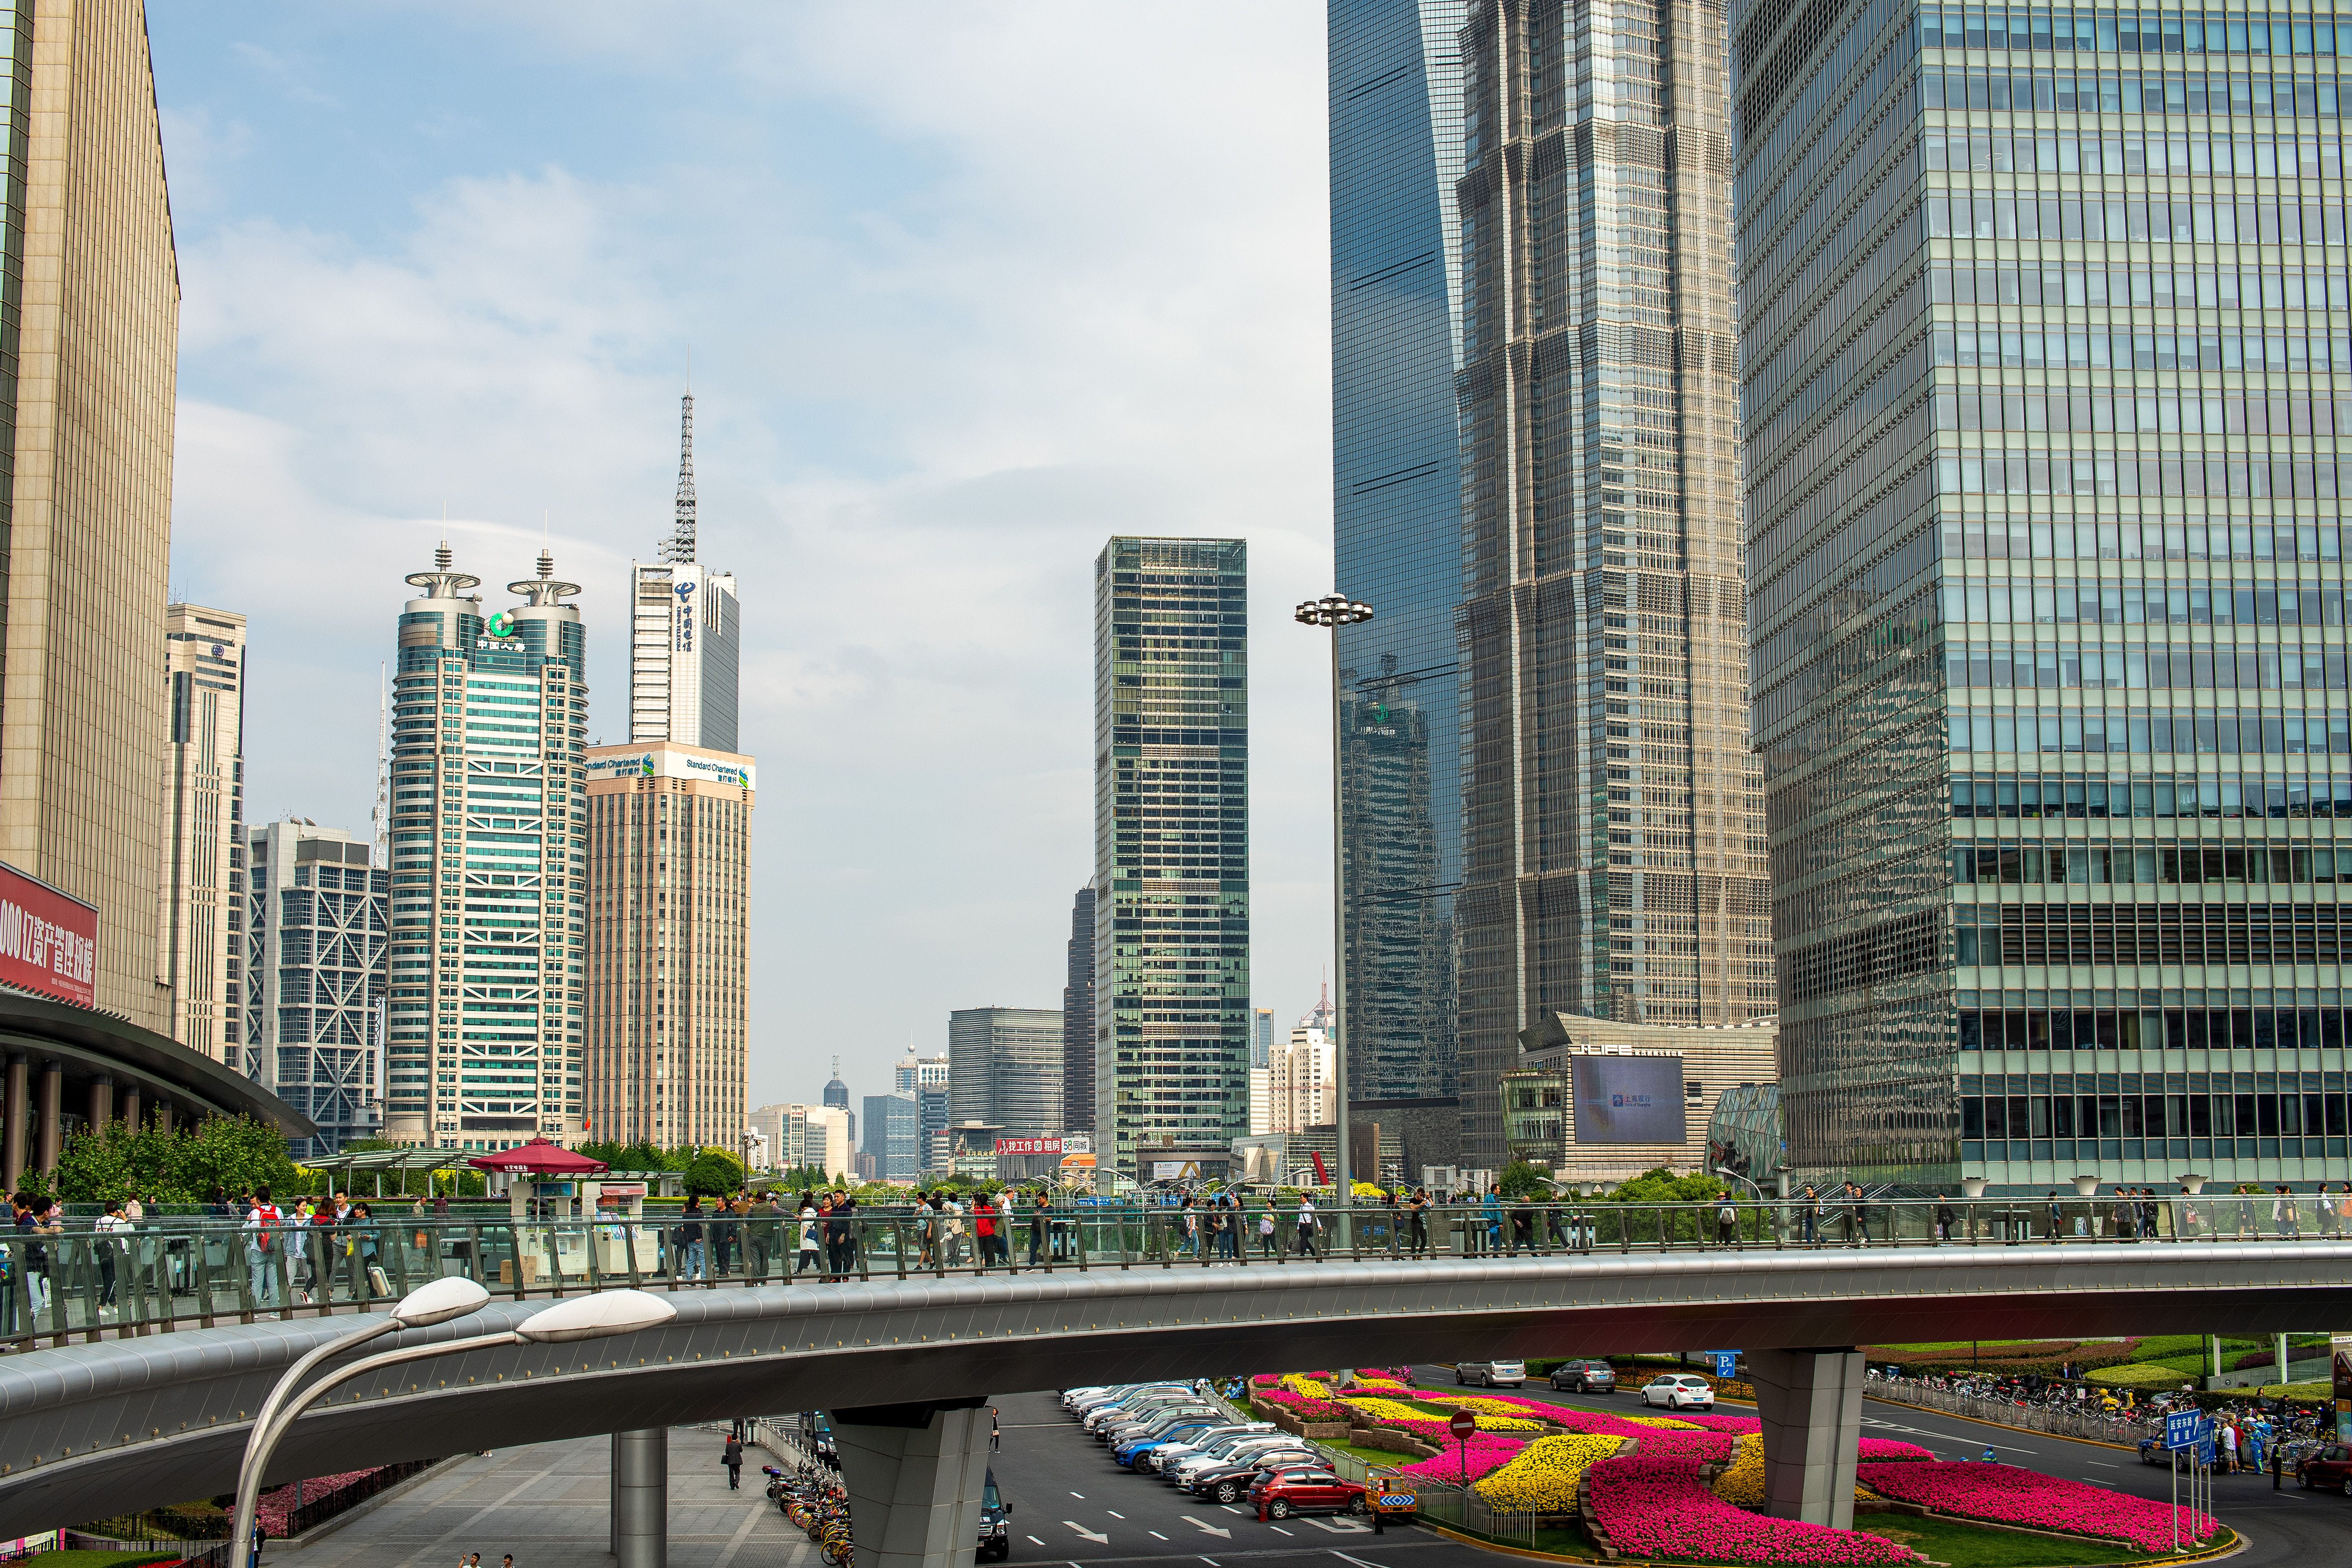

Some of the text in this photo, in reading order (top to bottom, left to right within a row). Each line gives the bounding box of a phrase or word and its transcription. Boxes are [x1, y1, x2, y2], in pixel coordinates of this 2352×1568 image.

[683, 605, 692, 652] 中国电信
[583, 757, 640, 770] andard Chartered
[687, 759, 737, 775] Standard Chartered
[615, 767, 640, 777] 渣打银行
[718, 775, 737, 784] 渣打银行
[1008, 1140, 1032, 1152] 找工作
[1044, 1140, 1060, 1151] 租房
[1064, 1140, 1087, 1151] 58同城
[1720, 1356, 1729, 1367] P
[2170, 1417, 2192, 1430] 延安东路
